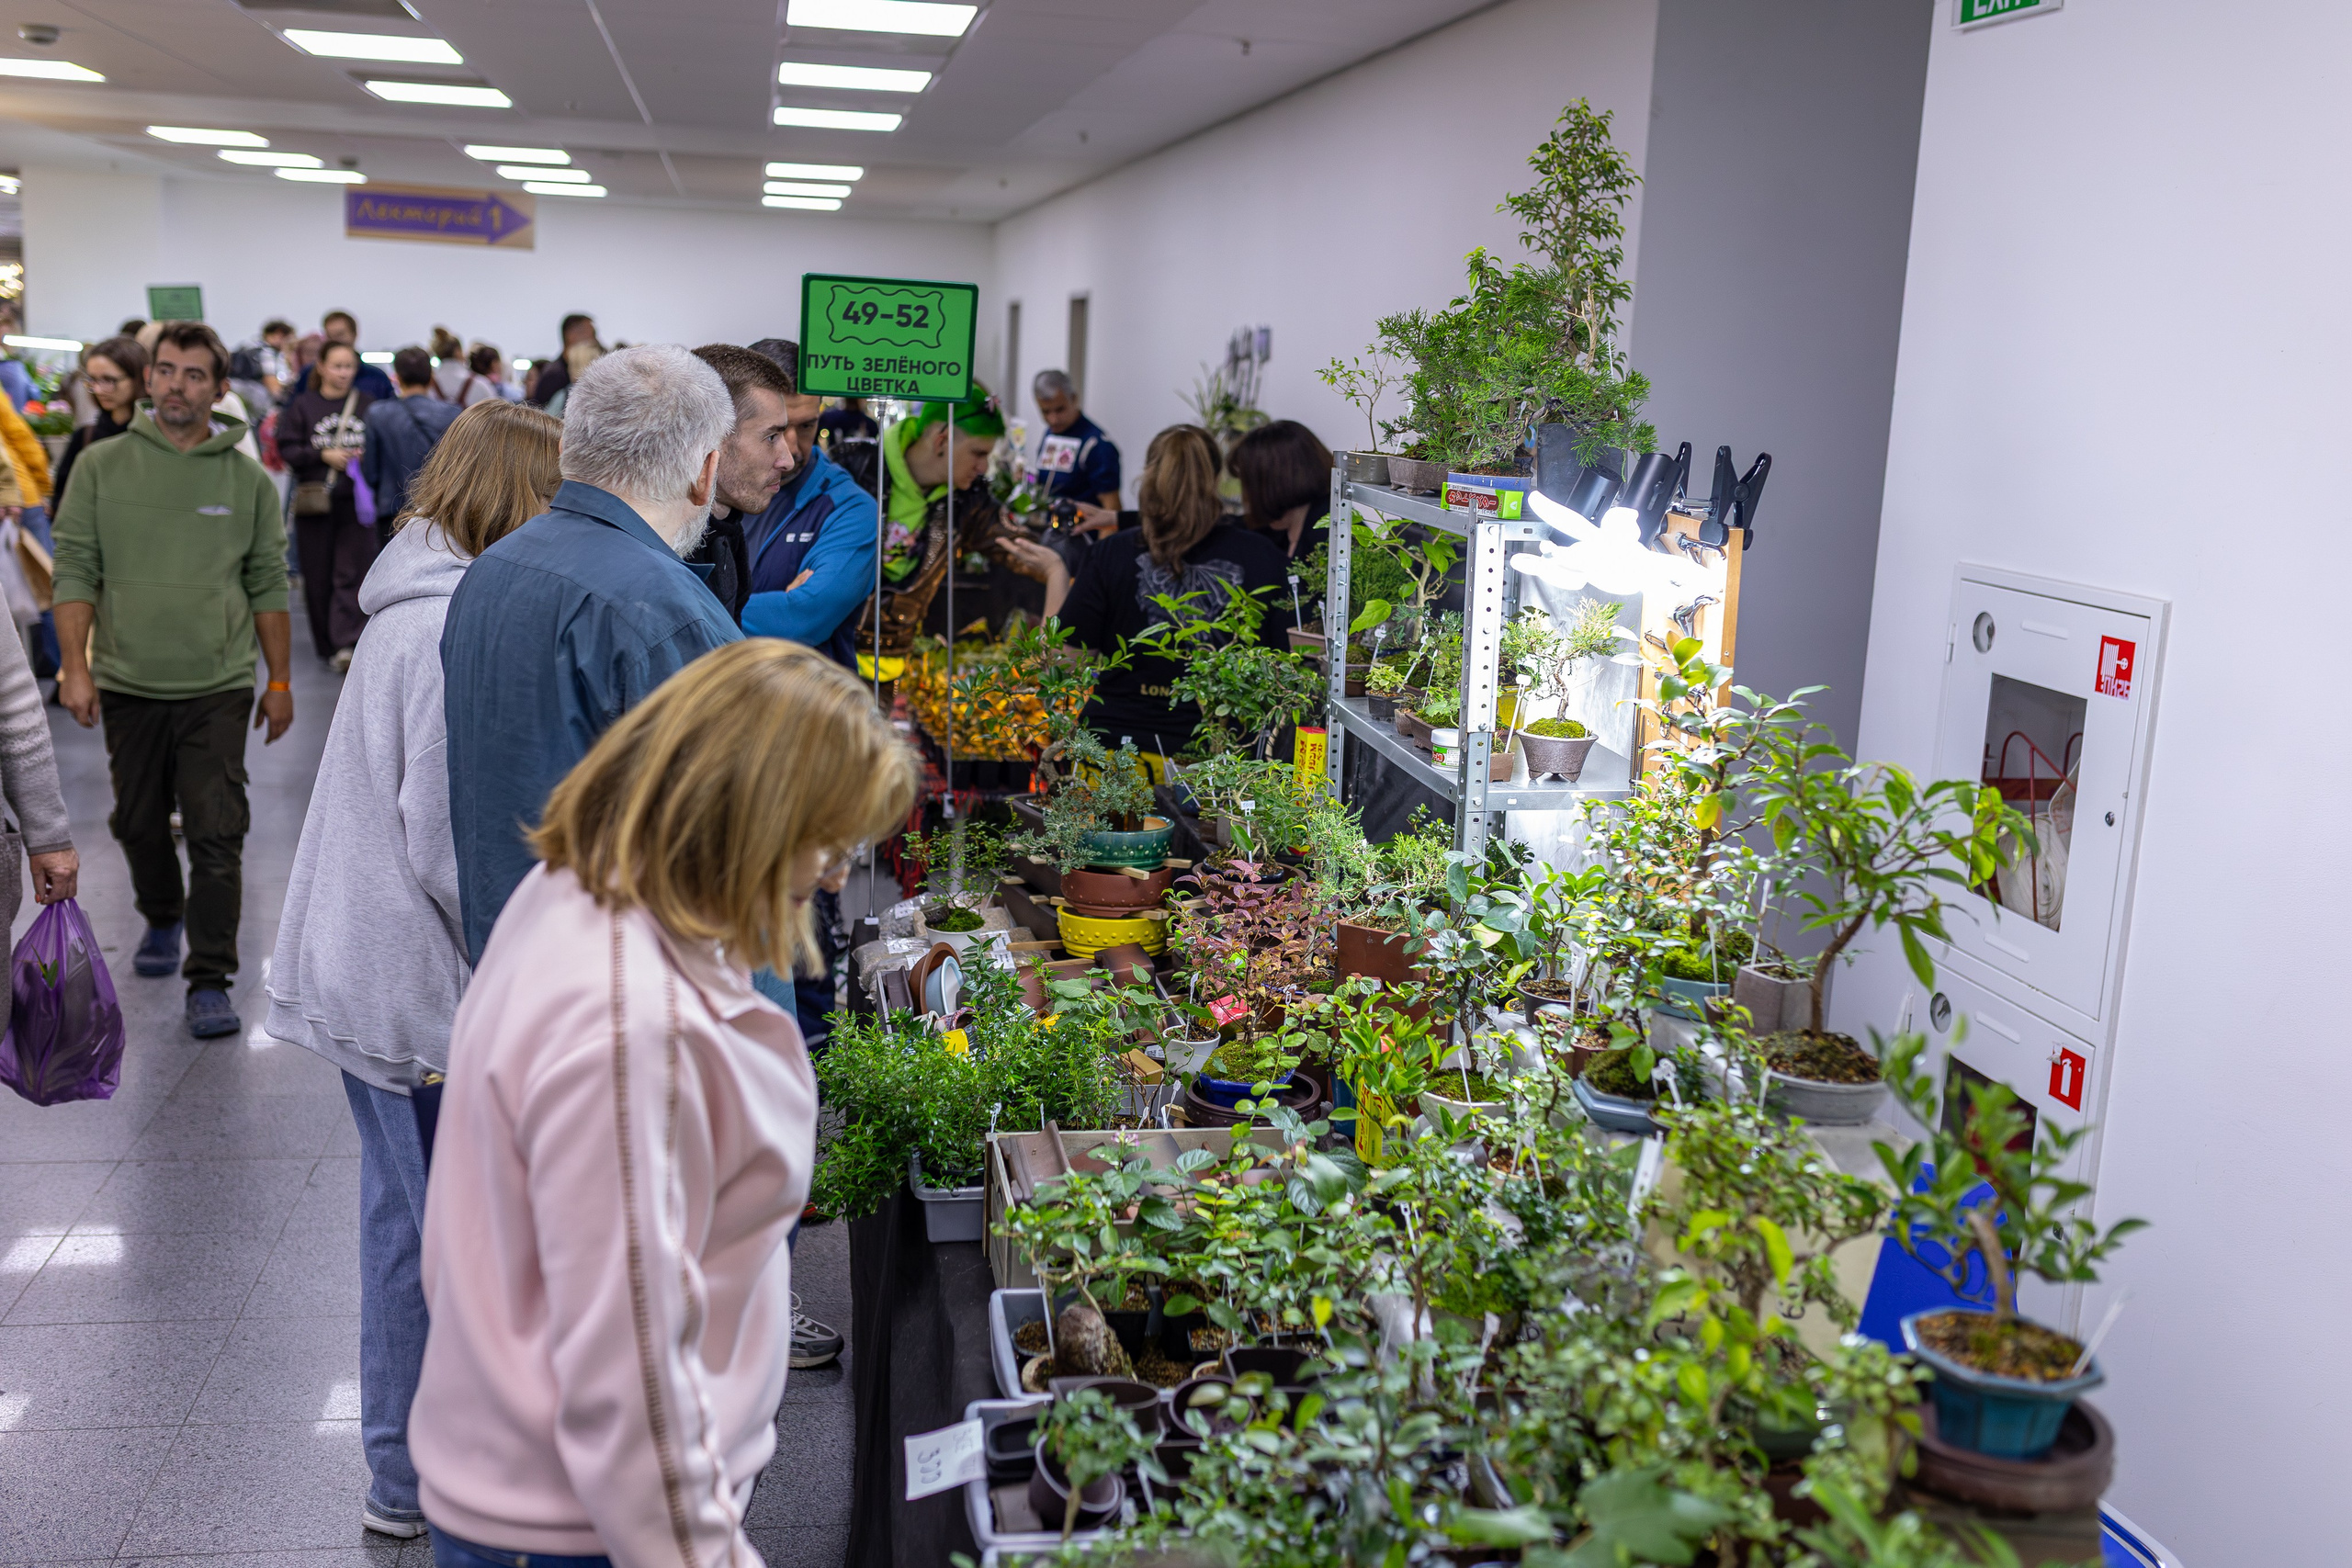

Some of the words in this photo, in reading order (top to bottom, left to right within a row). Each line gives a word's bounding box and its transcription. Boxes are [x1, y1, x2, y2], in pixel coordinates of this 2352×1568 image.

[490, 205, 502, 231] 1
[842, 300, 929, 329] 49-52
[808, 354, 854, 371] ПУТЬ
[863, 355, 961, 377] ЗЕЛЁНОГО
[846, 377, 920, 395] ЦВЕТКА
